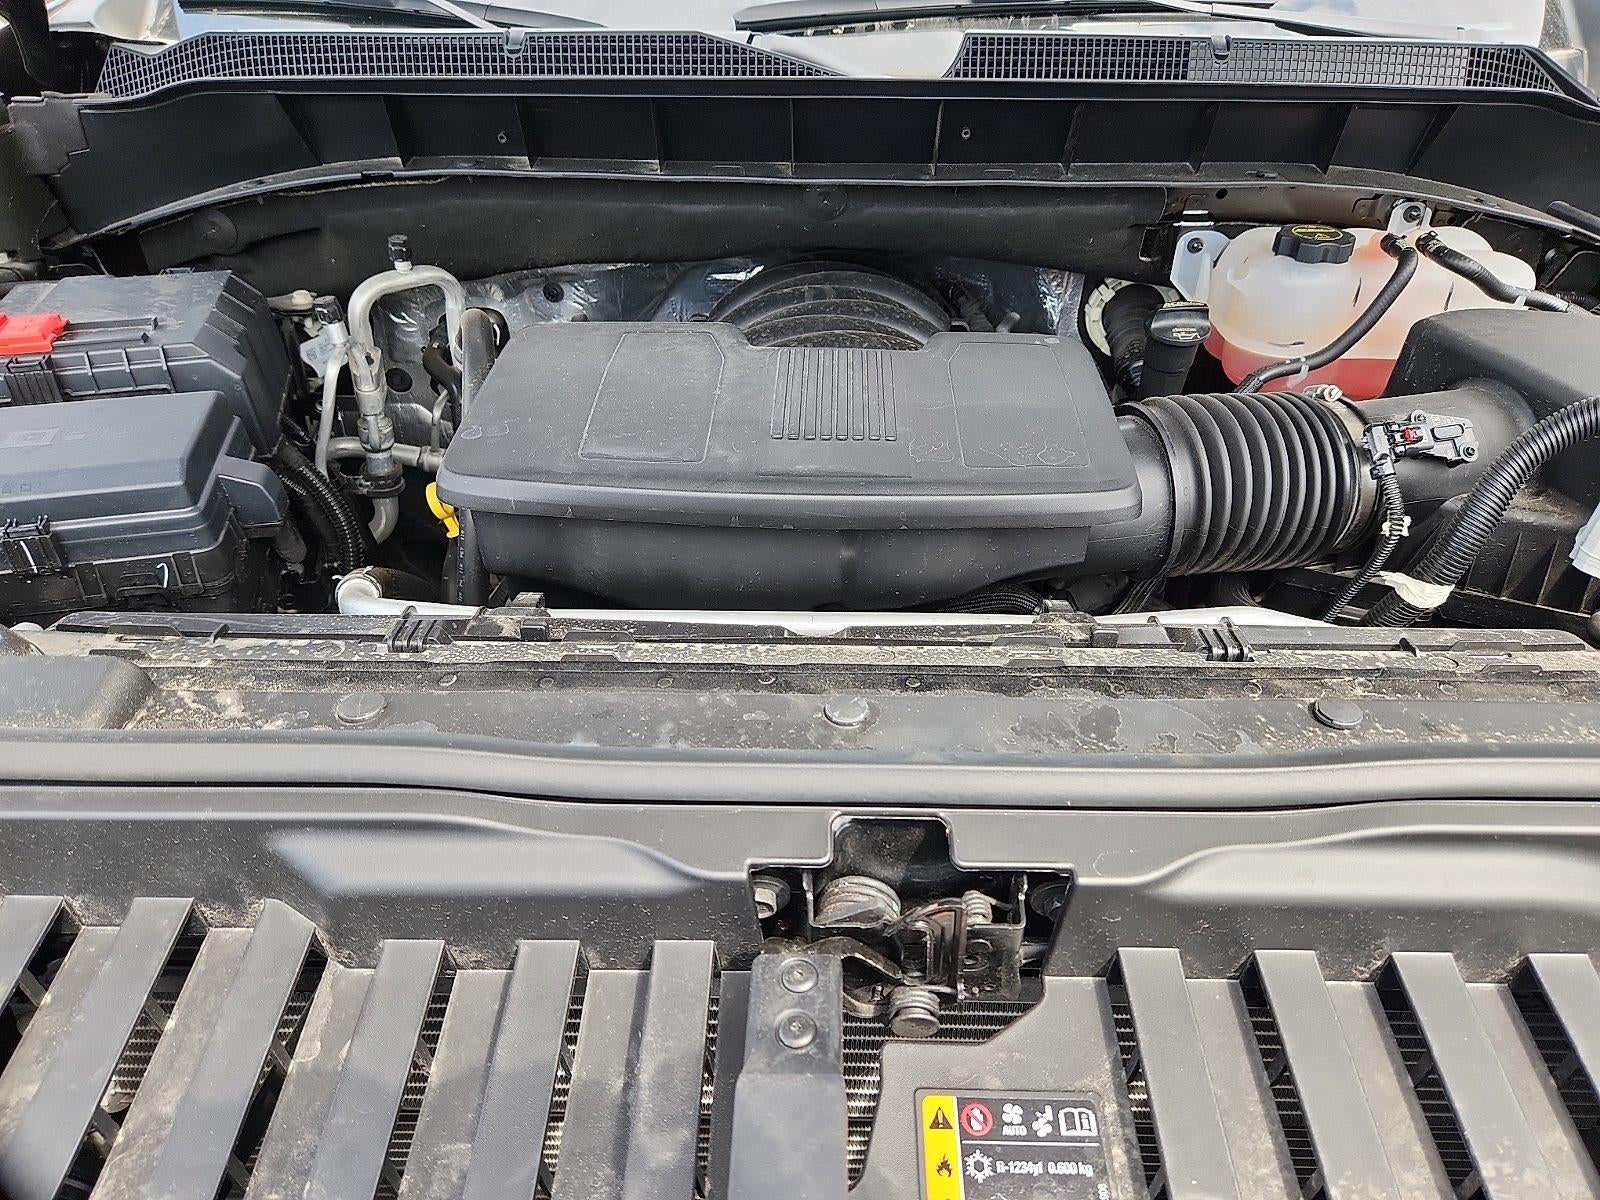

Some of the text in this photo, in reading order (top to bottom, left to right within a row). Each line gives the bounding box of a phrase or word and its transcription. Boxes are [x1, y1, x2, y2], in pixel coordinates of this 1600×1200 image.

[1002, 1125, 1027, 1135] AUTO
[996, 1161, 1043, 1176] R-1234yf
[1078, 1162, 1093, 1177] kg
